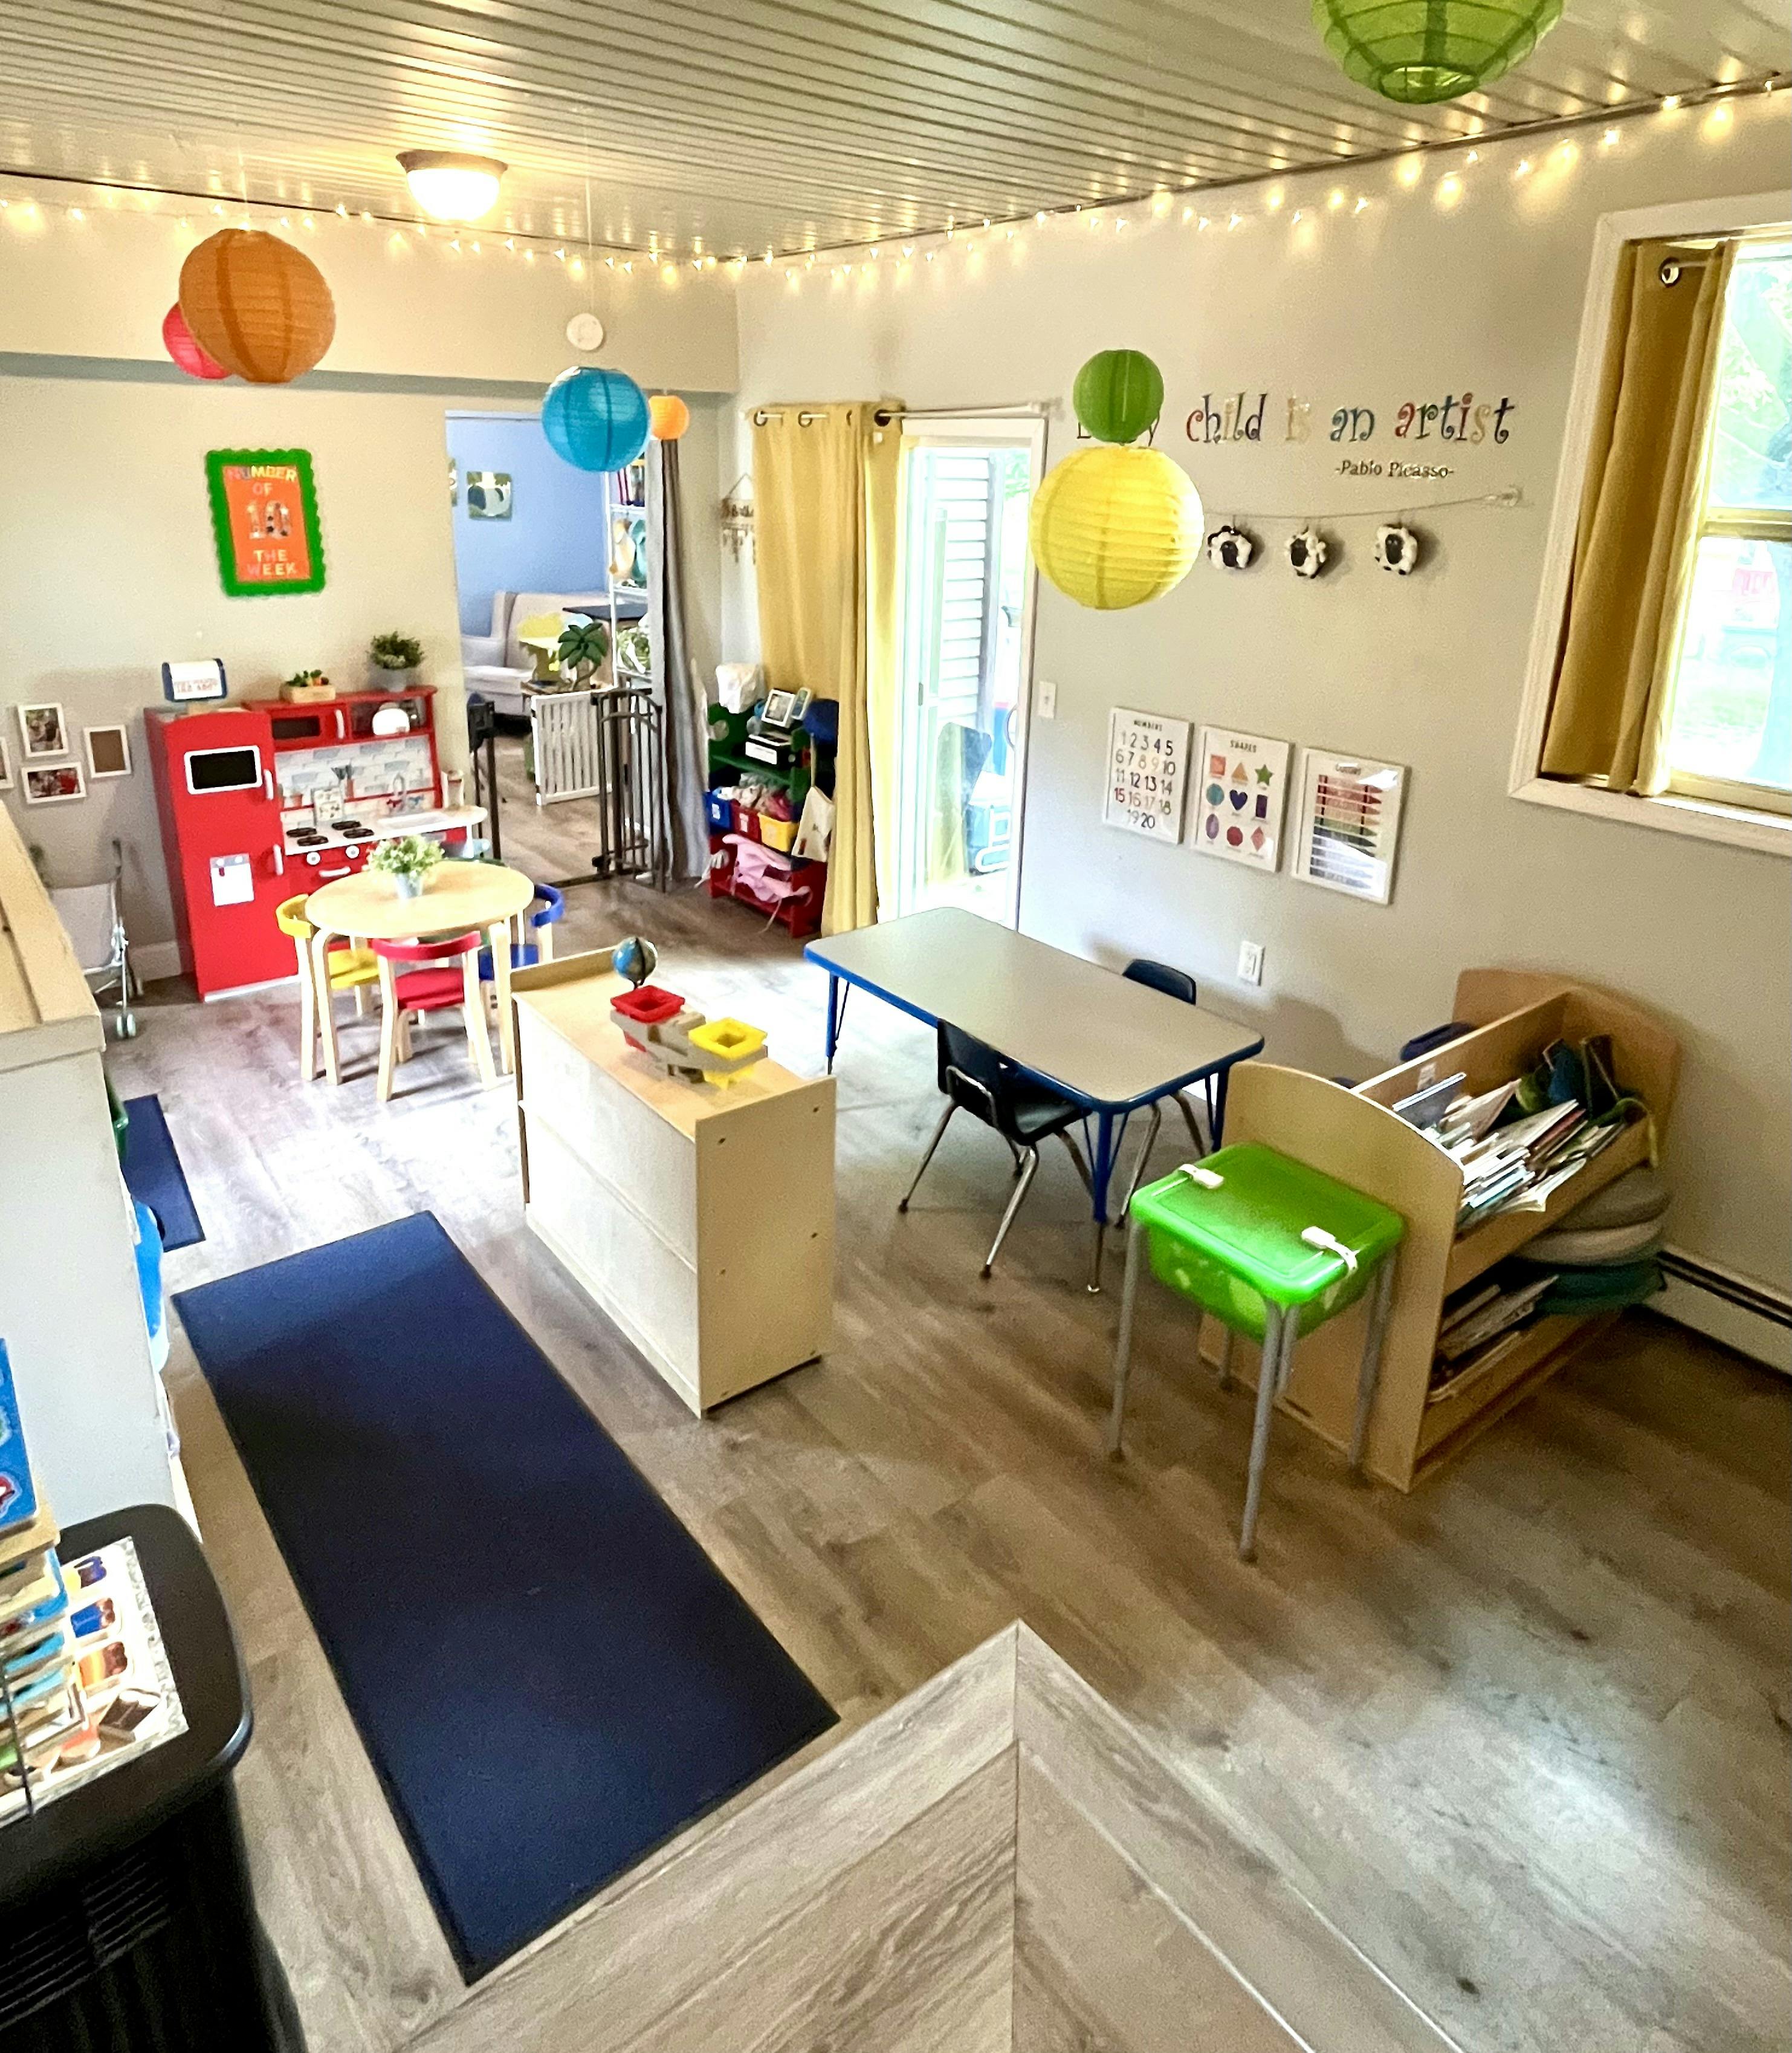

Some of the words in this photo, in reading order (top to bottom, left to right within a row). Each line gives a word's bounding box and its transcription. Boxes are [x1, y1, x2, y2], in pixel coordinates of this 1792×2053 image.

[1186, 392, 1267, 443] child
[1330, 407, 1375, 443] an
[1395, 392, 1515, 444] artist
[227, 465, 298, 482] NUMBER
[253, 482, 273, 496] OF
[253, 549, 288, 563] THE
[247, 562, 297, 578] WEEK
[1122, 730, 1127, 745] 1
[1130, 732, 1137, 748] 2
[1140, 735, 1148, 750] 3
[1154, 738, 1160, 753] 4
[1165, 740, 1173, 756] 5
[1229, 739, 1257, 753] SHAPES
[1116, 748, 1124, 764] 6
[1128, 750, 1134, 765] 7
[1139, 754, 1147, 770] 8
[1151, 757, 1159, 772] 9
[1163, 760, 1176, 776] 10
[1116, 768, 1125, 783] 11
[1130, 772, 1140, 788] 12
[1145, 776, 1157, 791] 13
[1161, 779, 1172, 796] 14
[1114, 787, 1125, 803] 15
[1128, 791, 1141, 807] 16
[1145, 795, 1155, 810] 17
[1160, 799, 1171, 815] 18
[1127, 809, 1139, 824] 19
[1141, 812, 1155, 829] 20
